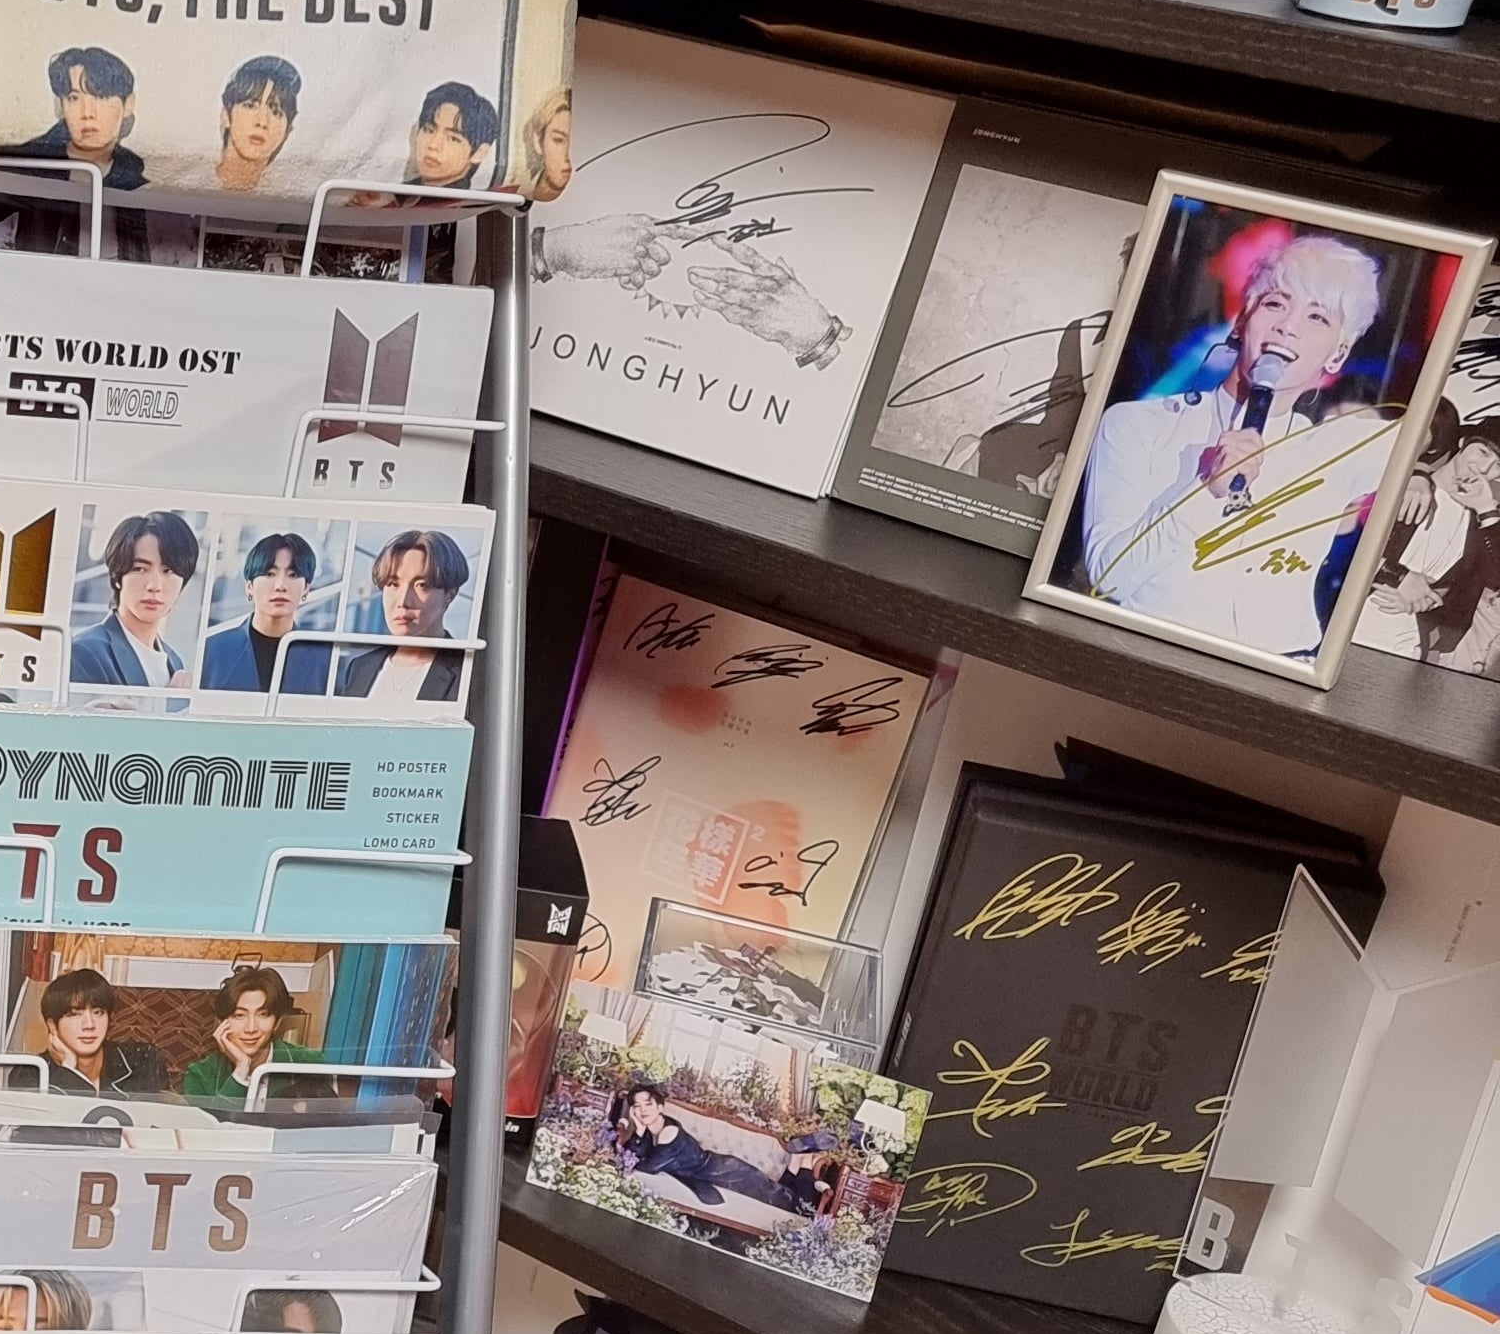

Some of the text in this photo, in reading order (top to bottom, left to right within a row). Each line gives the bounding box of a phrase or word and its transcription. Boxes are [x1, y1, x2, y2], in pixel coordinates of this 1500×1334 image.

[55, 338, 168, 370] WORLD
[178, 347, 242, 375] OST
[530, 326, 790, 425] JONGHYUN
[105, 387, 180, 420] WORLD
[313, 459, 397, 490] BTS
[376, 761, 448, 774] HD POSTER
[372, 787, 444, 799] BOOKMARK
[385, 813, 440, 824] STICKER
[363, 837, 436, 849] LOMO CARD
[1060, 1002, 1180, 1073] BTS
[1049, 1065, 1161, 1113] WORLD
[72, 1171, 254, 1253] BTS
